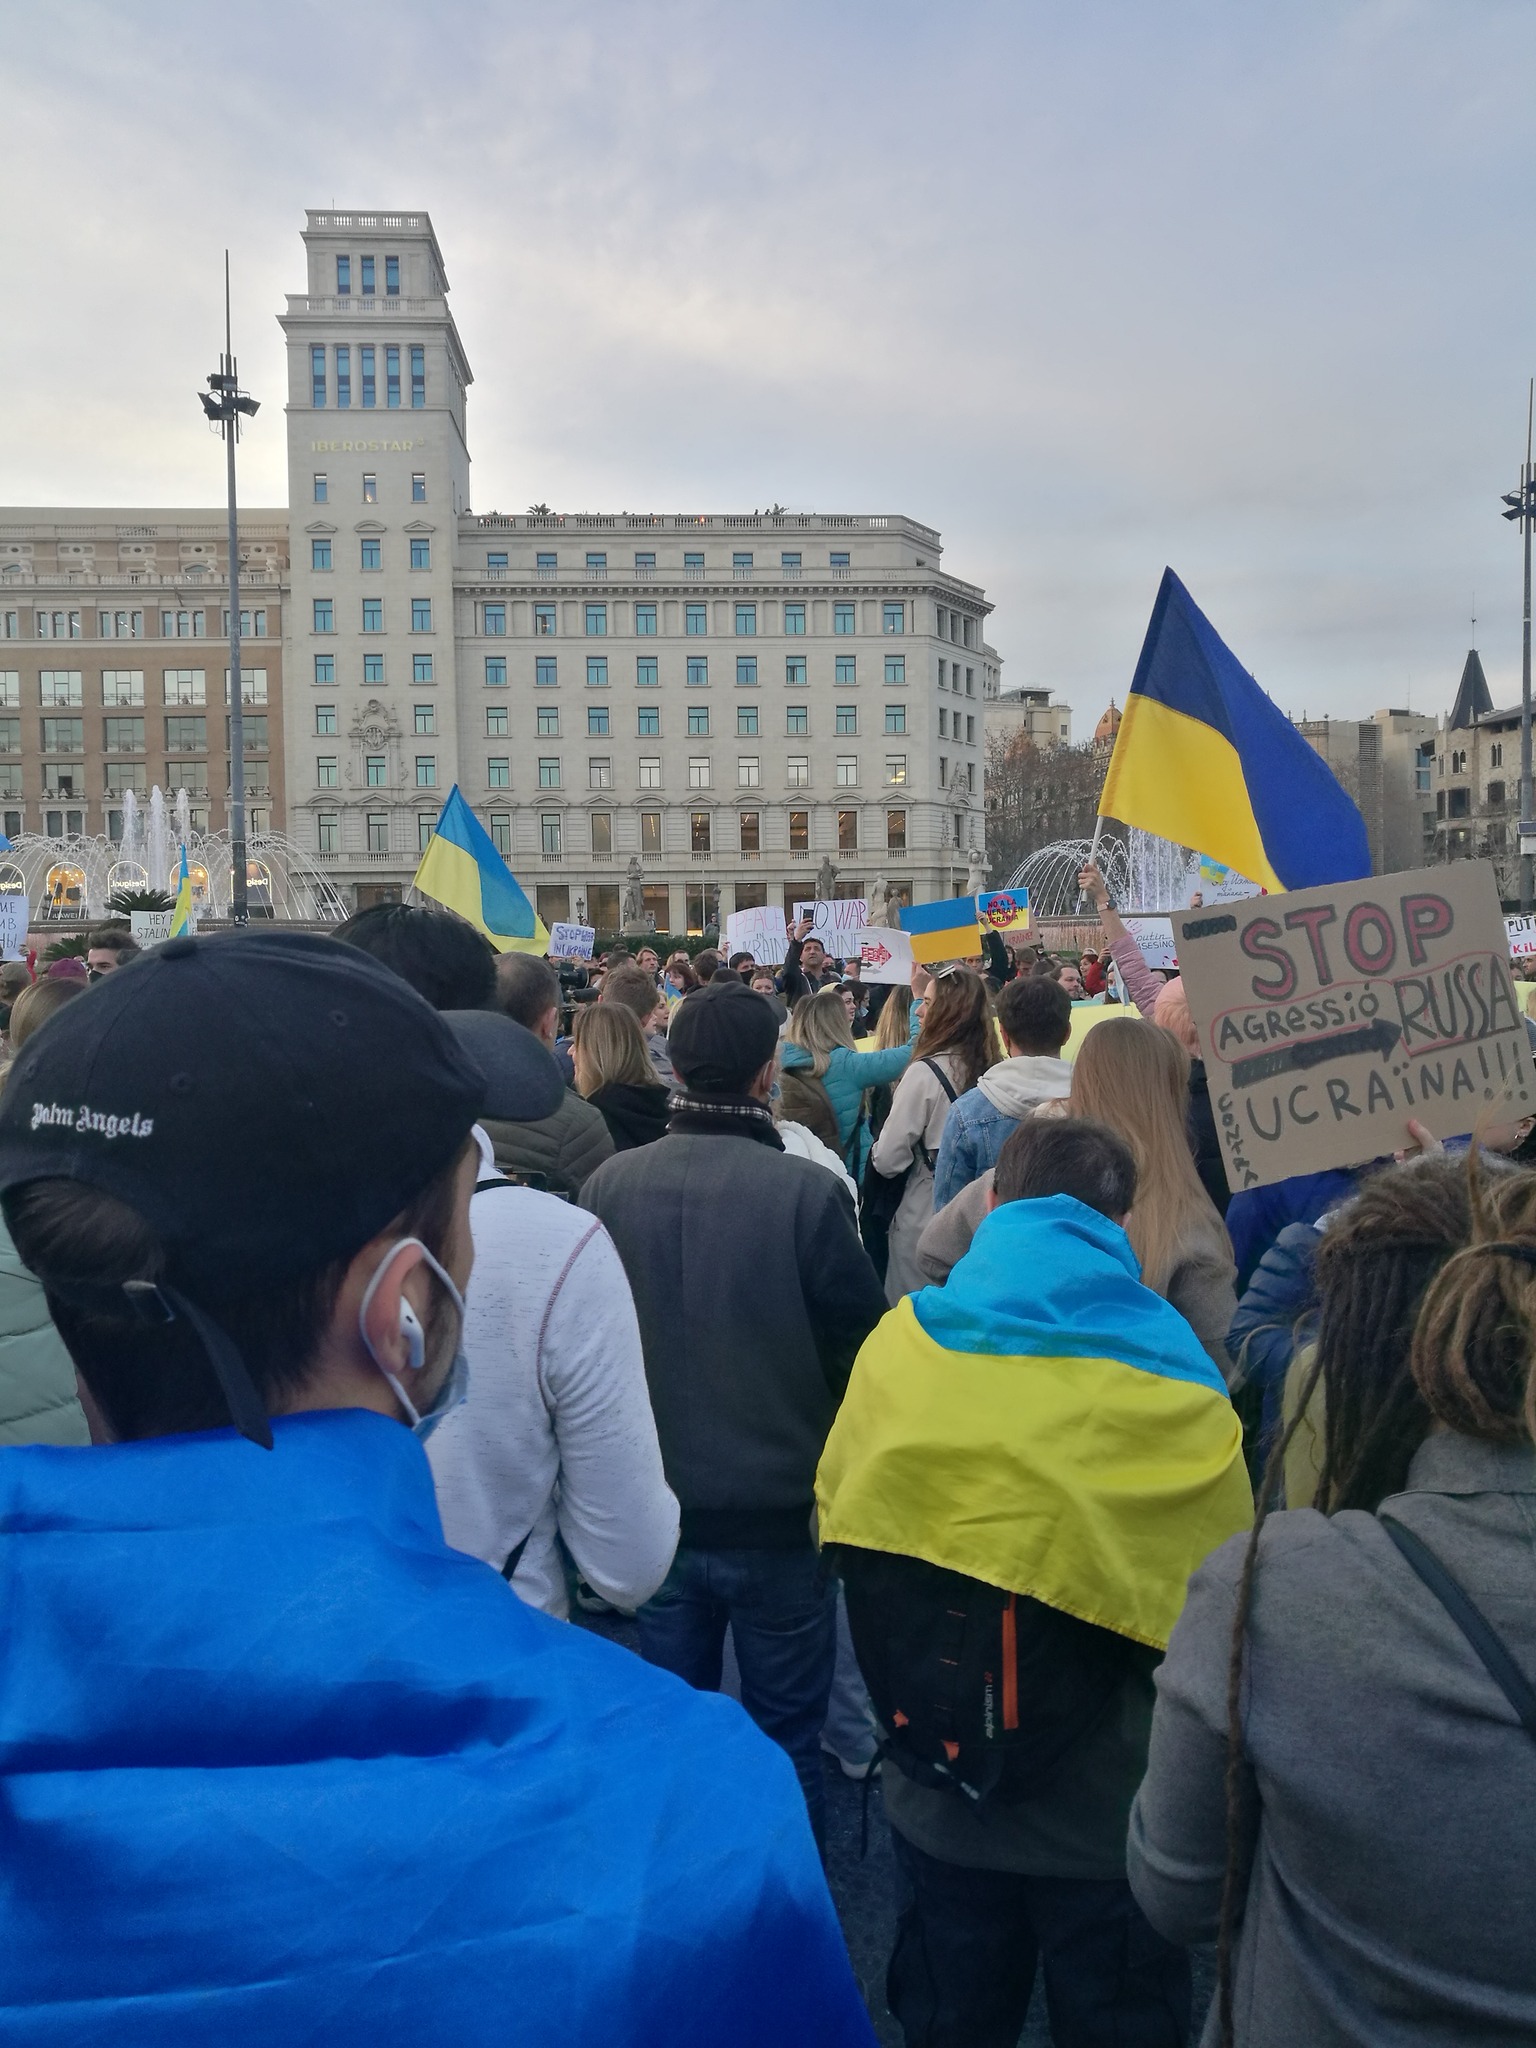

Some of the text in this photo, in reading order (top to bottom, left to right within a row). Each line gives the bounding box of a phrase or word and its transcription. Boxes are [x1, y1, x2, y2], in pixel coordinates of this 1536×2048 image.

[311, 440, 414, 452] IBEROSTAR
[833, 900, 866, 930] WAR
[987, 901, 998, 909] NO
[1000, 899, 1005, 907] A
[1013, 905, 1024, 913] EN
[148, 913, 167, 926] HEY
[735, 907, 783, 938] PEACE
[556, 925, 581, 941] STOP
[1240, 893, 1453, 1000] STOP
[1395, 955, 1521, 1046] RUSSA
[31, 1102, 154, 1139] Palm Angels
